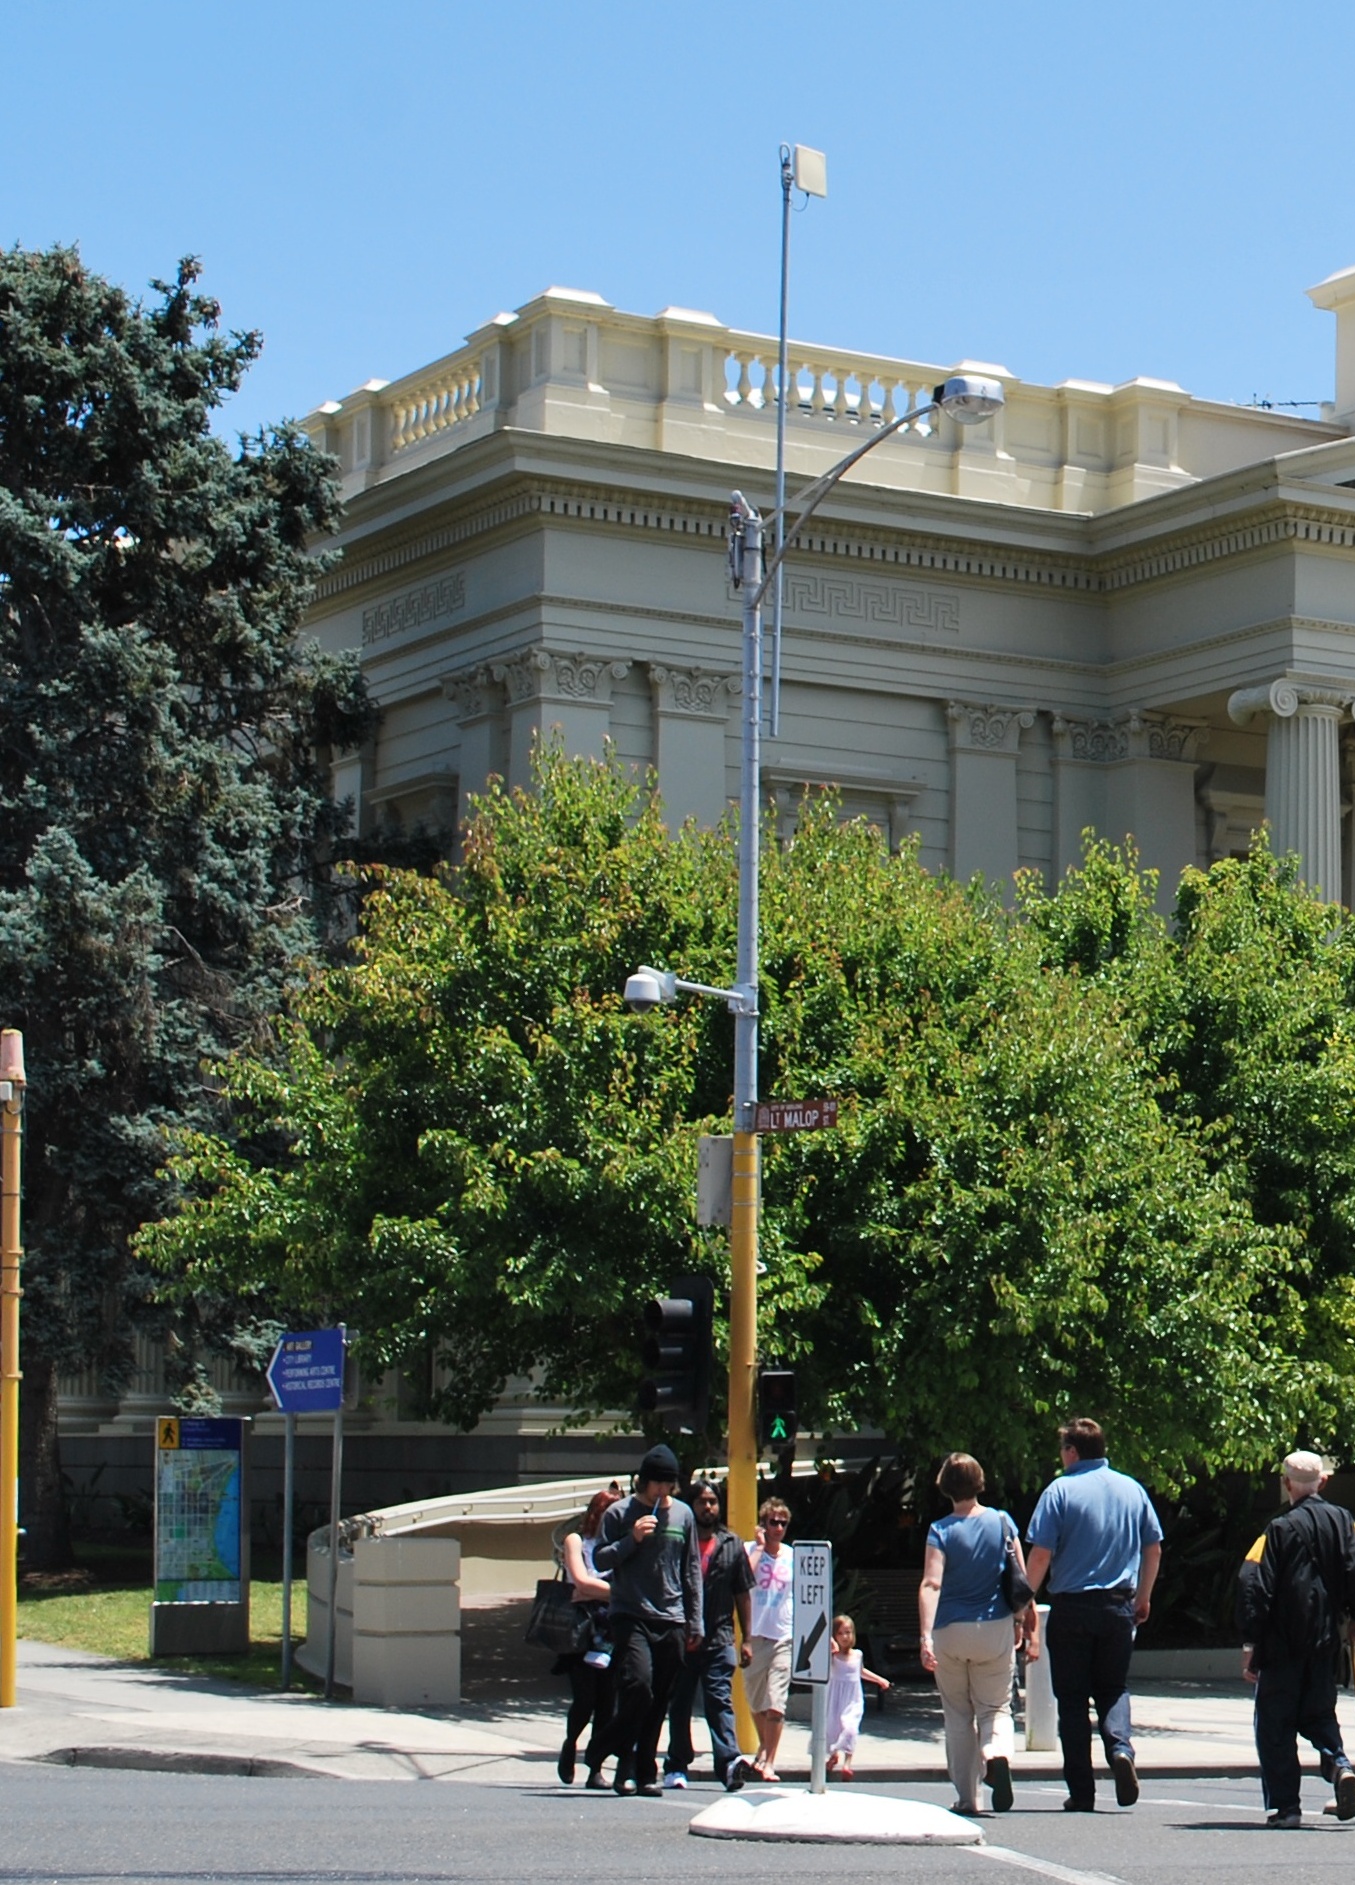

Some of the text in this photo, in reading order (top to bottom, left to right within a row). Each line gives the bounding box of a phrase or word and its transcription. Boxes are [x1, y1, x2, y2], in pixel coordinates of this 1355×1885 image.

[784, 1109, 820, 1128] MALOP
[800, 1556, 825, 1576] KEEP
[801, 1585, 824, 1605] LEFT
